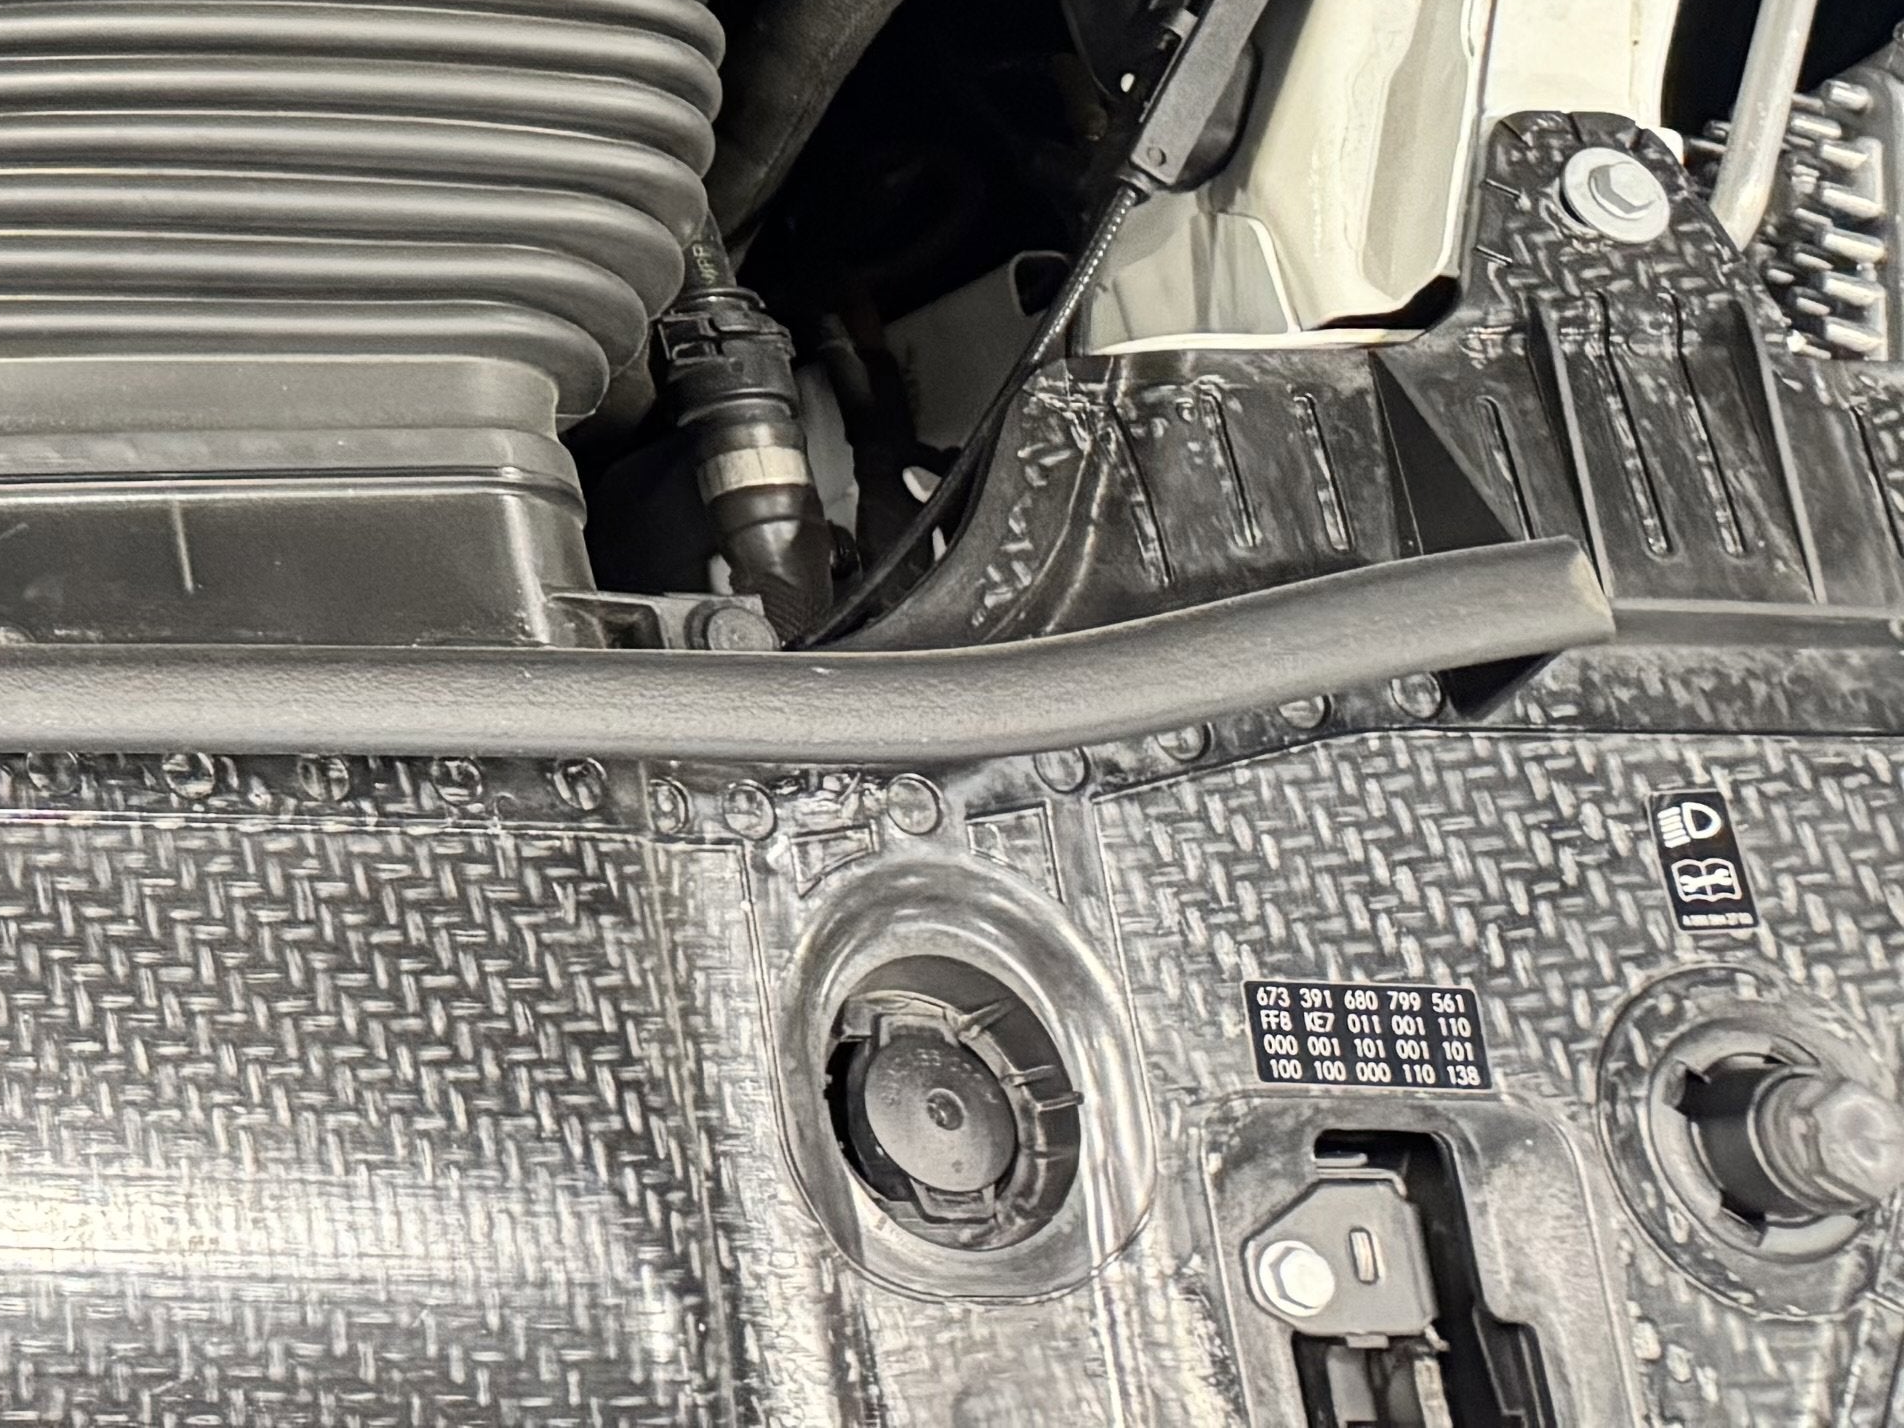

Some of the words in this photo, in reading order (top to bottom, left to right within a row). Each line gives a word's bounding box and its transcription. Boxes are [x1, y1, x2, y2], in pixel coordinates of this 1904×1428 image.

[1256, 987, 1290, 1007] 673
[1300, 988, 1332, 1008] 391
[1344, 990, 1378, 1010] 680
[1388, 991, 1420, 1011] 799
[1432, 994, 1464, 1013] 561
[1260, 1010, 1292, 1030] FF8
[1304, 1012, 1335, 1033] KE7
[1347, 1014, 1381, 1034] 011
[1392, 1016, 1425, 1035] 001
[1438, 1017, 1471, 1037] 110
[1264, 1035, 1298, 1055] 000
[1307, 1036, 1341, 1057] 001
[1354, 1038, 1385, 1058] 101
[1395, 1039, 1430, 1060] 001
[1442, 1041, 1474, 1061] 101
[1270, 1059, 1302, 1079] 100
[1315, 1060, 1346, 1080] 100
[1356, 1062, 1391, 1082] 000
[1402, 1064, 1436, 1084] 110
[1446, 1065, 1480, 1086] 138
